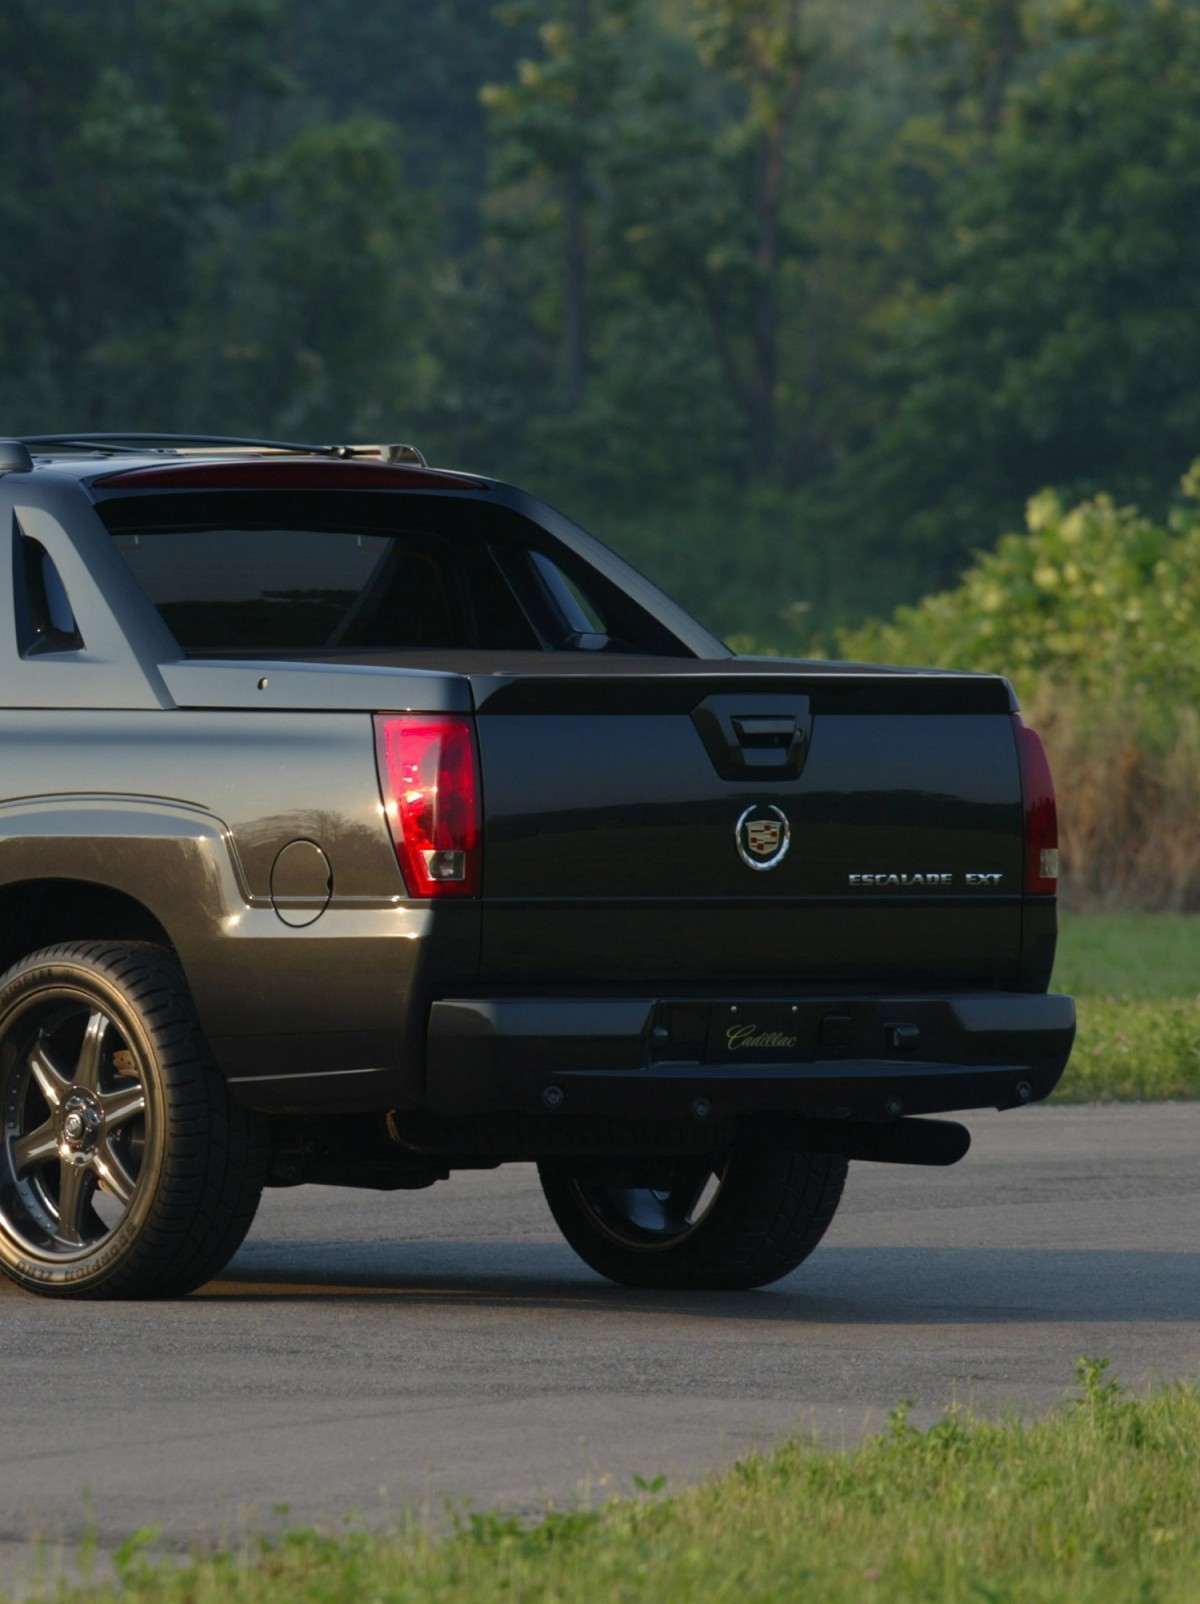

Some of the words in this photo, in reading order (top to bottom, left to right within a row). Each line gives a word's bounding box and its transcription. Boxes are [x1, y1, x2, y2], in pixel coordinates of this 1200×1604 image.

[847, 873, 953, 886] ESCALADE
[964, 873, 1004, 886] EXT
[726, 1024, 797, 1050] Cadillac
